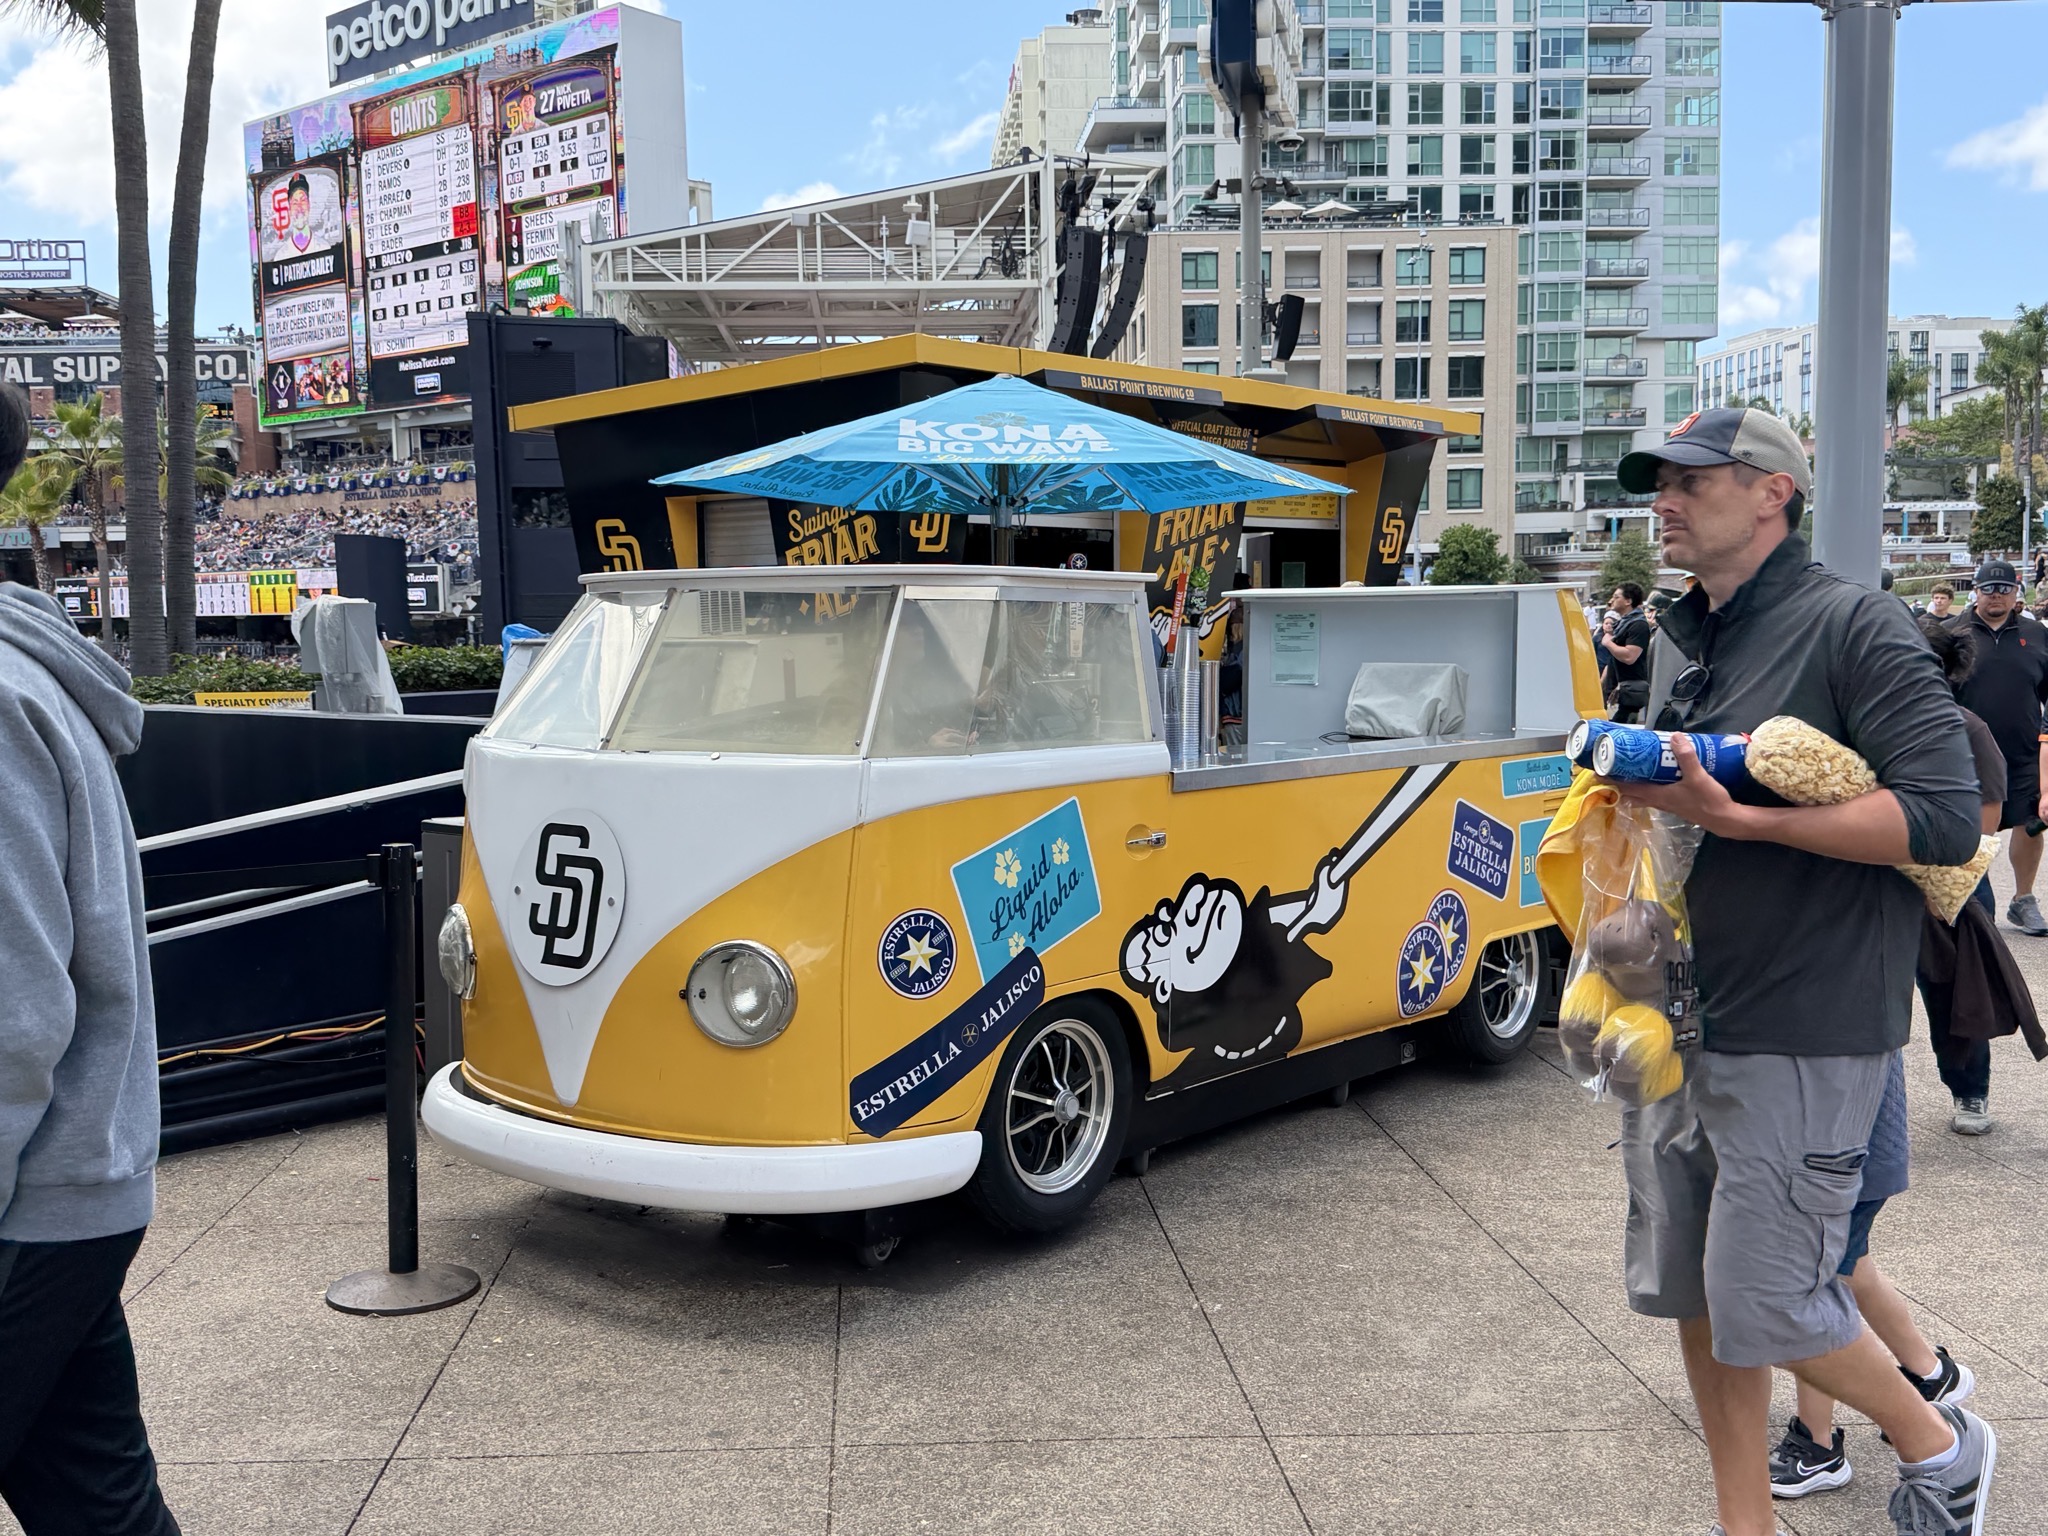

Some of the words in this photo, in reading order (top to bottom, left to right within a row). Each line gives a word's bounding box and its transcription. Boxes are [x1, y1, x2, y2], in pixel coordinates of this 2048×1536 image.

[328, 0, 430, 82] petco
[540, 88, 555, 114] 27
[557, 88, 592, 112] PIVETTA
[390, 96, 437, 137] GIANTS
[366, 154, 370, 164] 2
[377, 144, 404, 161] ADAMES
[436, 134, 445, 145] SS
[454, 127, 468, 140] .273
[507, 142, 520, 154] W-L
[534, 136, 547, 148] ERA
[562, 128, 573, 140] FIP
[592, 122, 600, 132] IP
[364, 168, 372, 180] 16
[378, 160, 402, 176] DEVERS
[436, 149, 446, 160] DH
[454, 144, 468, 156] .238
[508, 172, 523, 184] R/ER
[566, 160, 572, 170] K
[588, 151, 606, 165] WHIP
[510, 156, 520, 170] 0-1
[560, 142, 577, 157] 3.53
[366, 184, 372, 196] 17
[378, 176, 402, 192] RAMOS
[438, 164, 446, 176] LF
[455, 158, 470, 173] .200
[379, 190, 404, 207] ARRAEZ
[438, 180, 448, 192] 2B
[456, 174, 470, 188] .238
[510, 186, 523, 200] 6/6
[540, 180, 545, 192] 8
[567, 174, 574, 186] 11
[591, 166, 604, 180] 1.77
[366, 214, 374, 225] 26
[380, 204, 412, 222] CHAPMAN
[440, 195, 448, 208] 3B
[457, 191, 471, 204] .200
[546, 195, 560, 208] DUE
[560, 192, 568, 204] UP
[368, 228, 374, 240] 51
[380, 224, 392, 236] LEE
[440, 210, 448, 223] RF
[510, 219, 516, 232] 7
[524, 212, 554, 229] SHEETS
[0, 238, 70, 261] Ortho
[370, 244, 374, 254] 9
[382, 236, 404, 252] BADER
[440, 226, 450, 238] CF
[512, 234, 518, 248] 8
[526, 228, 554, 246] FERMIN
[368, 258, 376, 269] 14
[382, 252, 406, 268] BAILEY
[443, 242, 449, 254] C
[462, 262, 474, 272] SLG
[512, 251, 518, 264] 9
[526, 244, 559, 262] JOHNSO
[30, 270, 66, 278] PARTNER
[272, 268, 278, 286] C
[284, 260, 312, 284] PATRICK
[310, 255, 334, 278] BAILEY
[515, 277, 544, 291] JOHNSON
[376, 292, 382, 303] 17
[420, 284, 424, 295] 2
[276, 304, 297, 320] TAUGHT
[298, 299, 320, 315] HIMSELF
[322, 296, 334, 310] HOW
[268, 323, 275, 336] TO
[276, 320, 289, 334] PLAY
[290, 316, 308, 332] CHESS
[308, 315, 316, 328] BY
[316, 310, 346, 326] WATCHING
[268, 332, 294, 350] YOUTUBE
[295, 328, 324, 346] TUTORIALS
[325, 326, 331, 338] IN
[332, 324, 346, 338] 2023
[378, 322, 382, 333] 0
[400, 319, 405, 330] 0
[422, 316, 426, 326] 0
[374, 343, 380, 354] 10
[386, 336, 415, 352] SCHMITT
[446, 331, 454, 342] 1B
[0, 356, 44, 383] AL
[53, 355, 168, 383] SUPY
[398, 356, 456, 372] MelissaTucci.com
[1081, 376, 1118, 392] BALLAST
[1120, 380, 1146, 394] POINT
[1146, 384, 1185, 399] BREWING
[900, 418, 1108, 442] KONA
[1172, 420, 1202, 432] OFFICIAL
[1203, 424, 1224, 436] CRAFT
[1224, 426, 1241, 437] BEER
[1242, 428, 1252, 438] OF
[1341, 410, 1368, 422] BALLAST
[1370, 414, 1388, 426] POINT
[1388, 415, 1417, 428] BREWING
[898, 437, 974, 454] BIG
[1222, 438, 1248, 450] PADRES
[344, 492, 378, 501] ESTRELLA
[380, 488, 408, 498] JALISCO
[410, 486, 442, 498] LANDING
[785, 514, 880, 566] FRIAR
[1154, 502, 1237, 552] FRIAR
[1164, 535, 1218, 590] ALE
[204, 698, 256, 708] SPECIALTY
[1516, 778, 1537, 792] KONA
[1540, 774, 1561, 788] MODE
[1453, 830, 1508, 874] ESTRELLA
[1455, 851, 1501, 886] JALISCO
[529, 822, 604, 970] SD
[990, 844, 1050, 942] Liquid
[1028, 868, 1080, 944] Aloha
[1428, 896, 1458, 924] TRELLA
[884, 916, 935, 960] ESTRELLA
[1404, 928, 1442, 962] ESTRELLA
[912, 958, 951, 993] JALISCO
[1446, 943, 1466, 980] LISCO
[1404, 992, 1436, 1014] JALISCO
[854, 1042, 962, 1121] ESTRELLA
[980, 965, 1041, 1032] JALISCO
